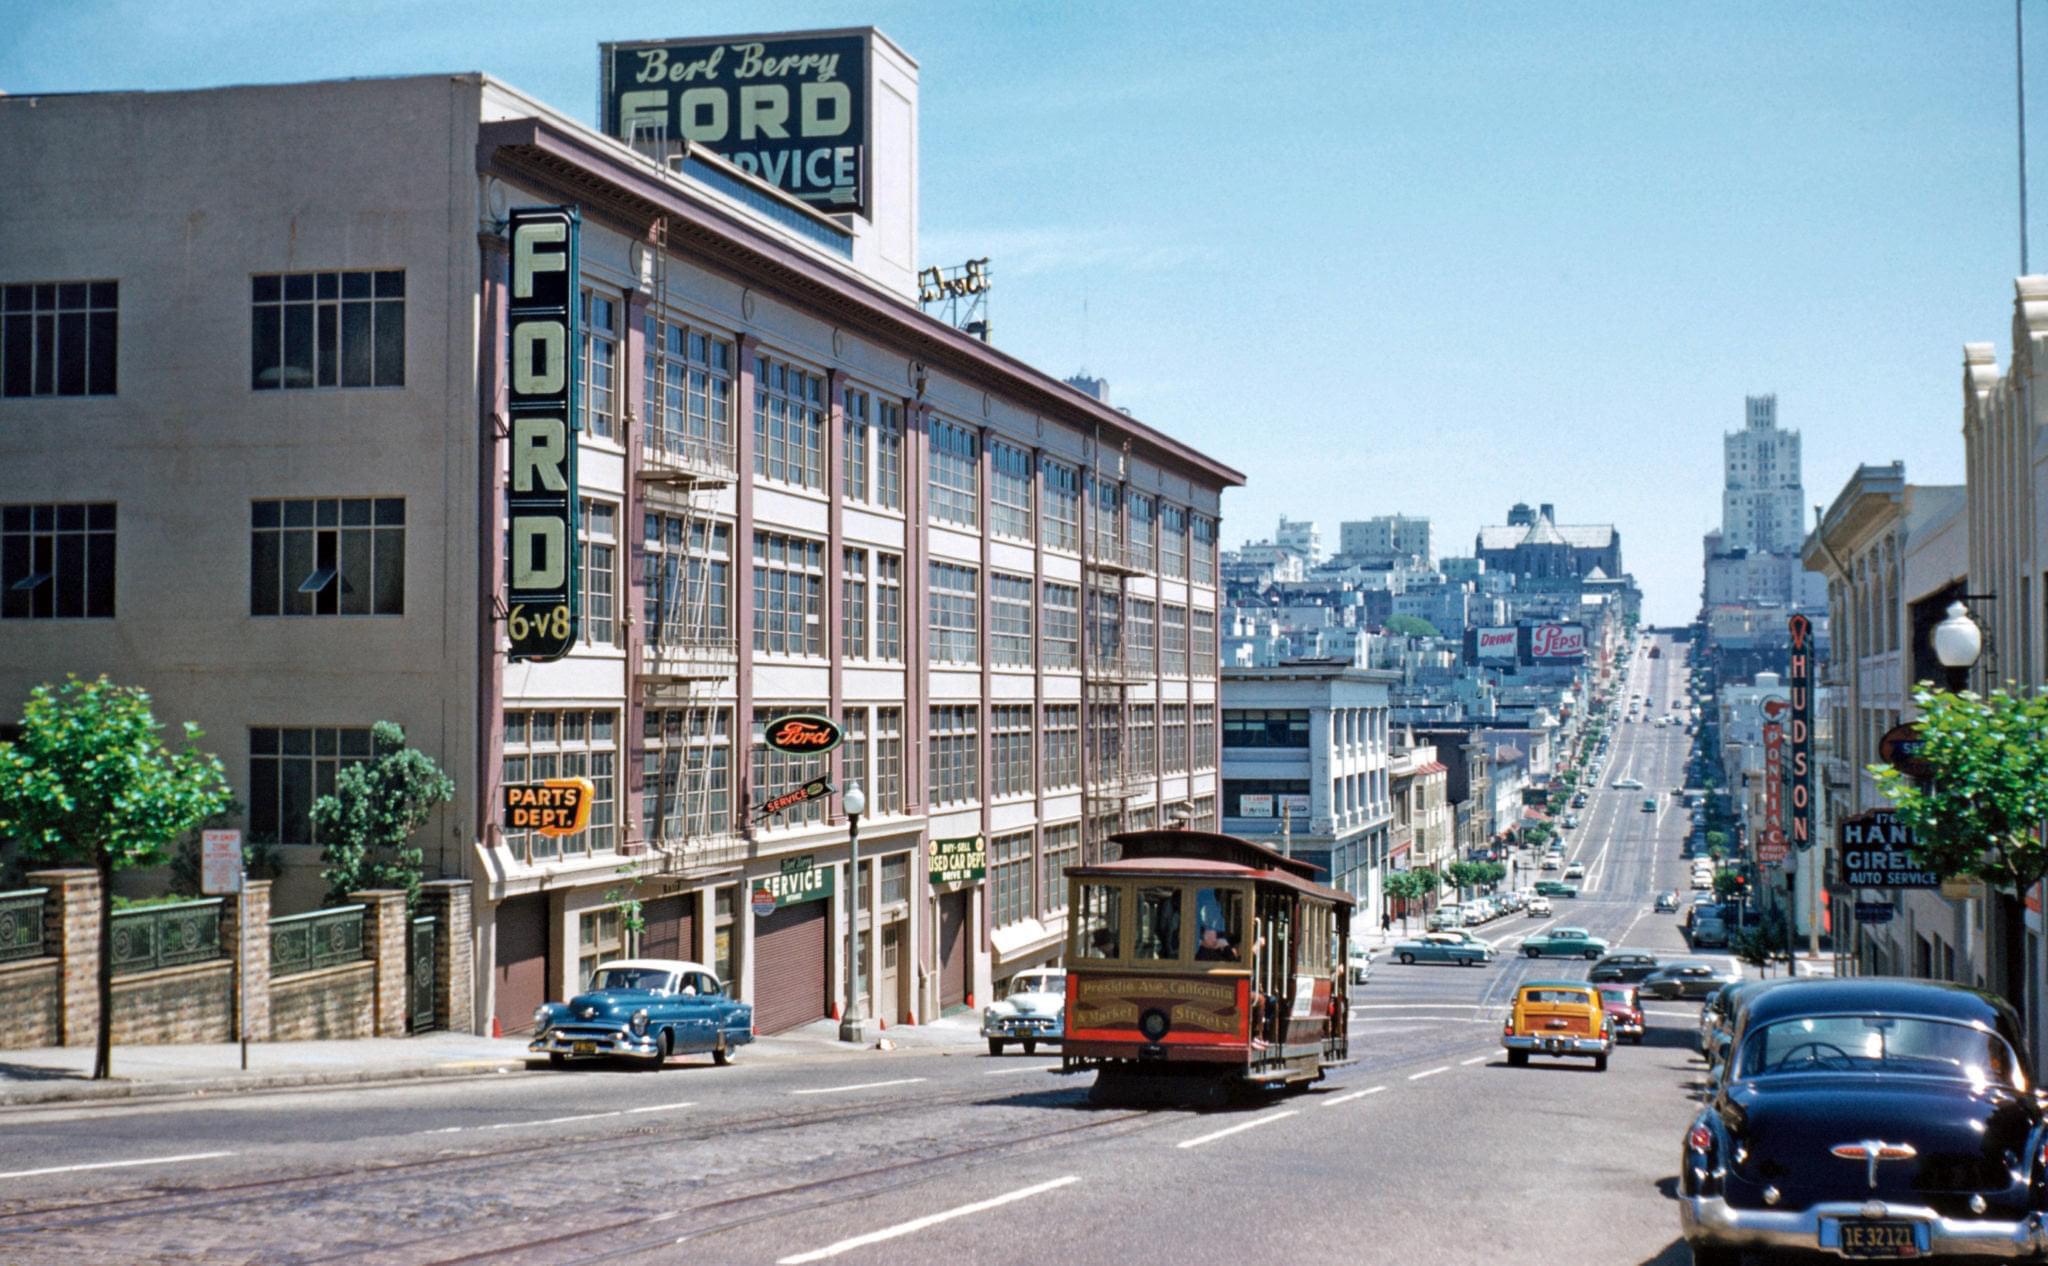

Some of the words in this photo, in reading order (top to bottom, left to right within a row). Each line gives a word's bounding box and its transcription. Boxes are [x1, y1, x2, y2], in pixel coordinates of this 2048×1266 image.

[636, 46, 725, 83] Berl
[731, 42, 840, 82] Berry
[620, 81, 851, 143] FORD
[720, 147, 855, 188] RVICE
[513, 222, 568, 590] FORD
[775, 721, 831, 746] Ford
[1792, 654, 1808, 841] HUDSON
[508, 788, 577, 806] PARTS
[766, 787, 809, 813] SERVICE
[1767, 730, 1781, 844] PONTIAC
[513, 808, 573, 827] DEPT.
[928, 854, 949, 872] USED
[949, 853, 966, 870] CAR
[763, 868, 823, 897] SERVICE
[1850, 872, 1882, 884] AUTO
[1887, 872, 1937, 884] SERVICE
